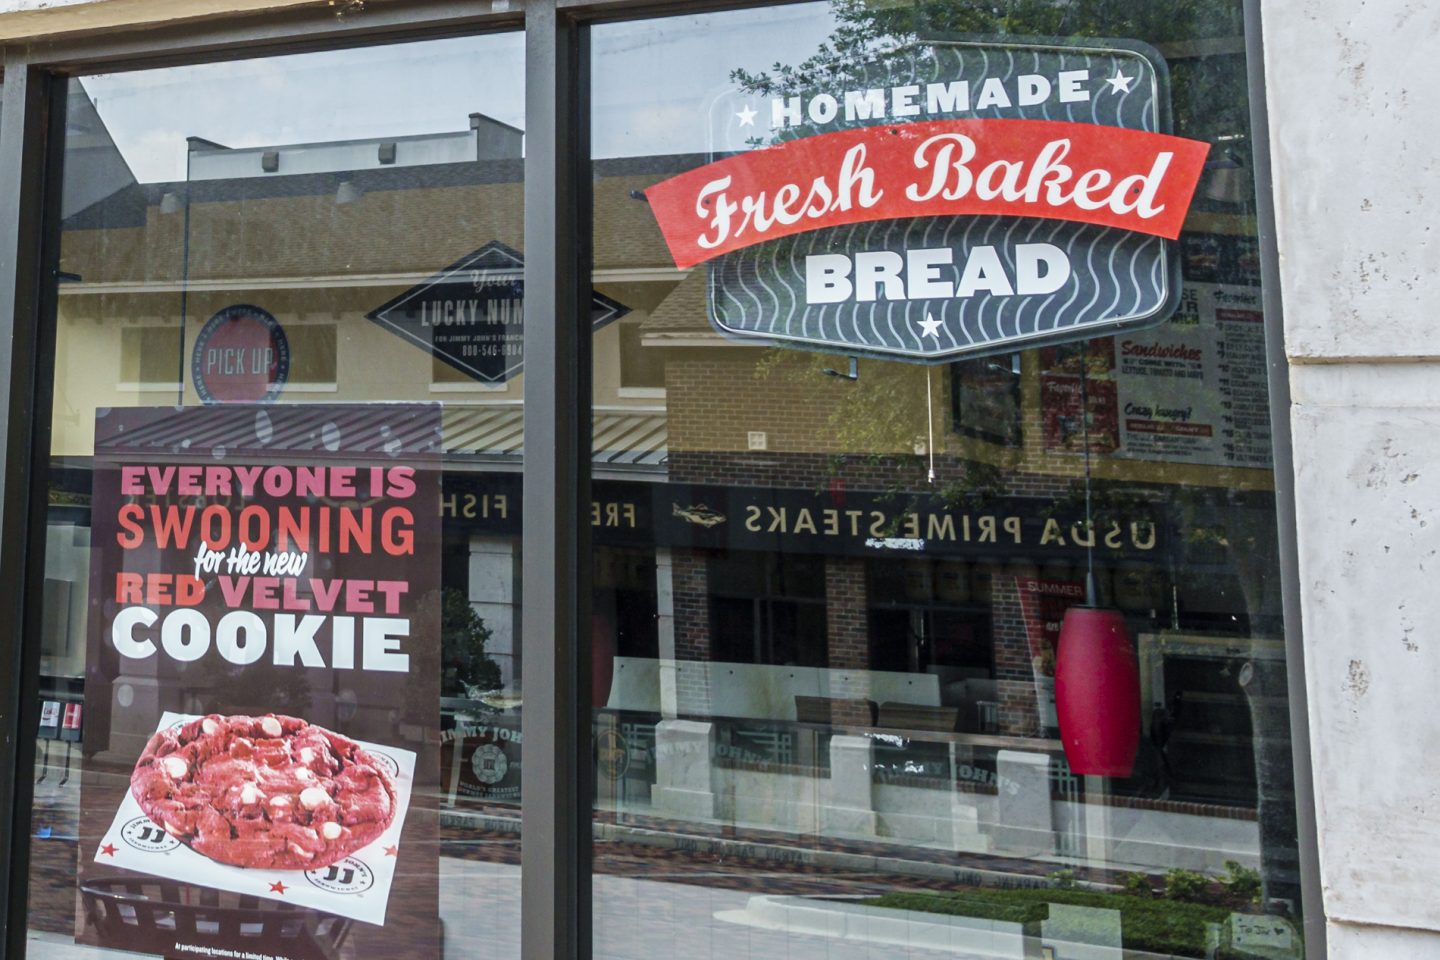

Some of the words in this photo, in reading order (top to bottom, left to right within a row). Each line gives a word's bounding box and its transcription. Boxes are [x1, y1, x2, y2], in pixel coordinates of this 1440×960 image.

[770, 69, 1091, 128] HOMEMADE
[695, 142, 884, 250] Fresh
[905, 132, 1176, 220] Baked
[470, 269, 518, 293] Your
[805, 242, 1072, 305] BREAD
[421, 299, 479, 327] LUCKY
[207, 348, 245, 375] PICK
[252, 347, 273, 375] UP
[1121, 340, 1203, 361] Sandwiches
[120, 466, 359, 498] EVERYONE
[370, 466, 417, 498] IS
[117, 505, 415, 555] SWOONING
[194, 541, 226, 581] for
[226, 542, 261, 575] the
[263, 551, 308, 577] new
[115, 572, 205, 606] RED
[218, 575, 409, 614] VELVET
[112, 606, 410, 672] COOKIE
[137, 826, 167, 843] JJ
[323, 865, 354, 884] JJ
